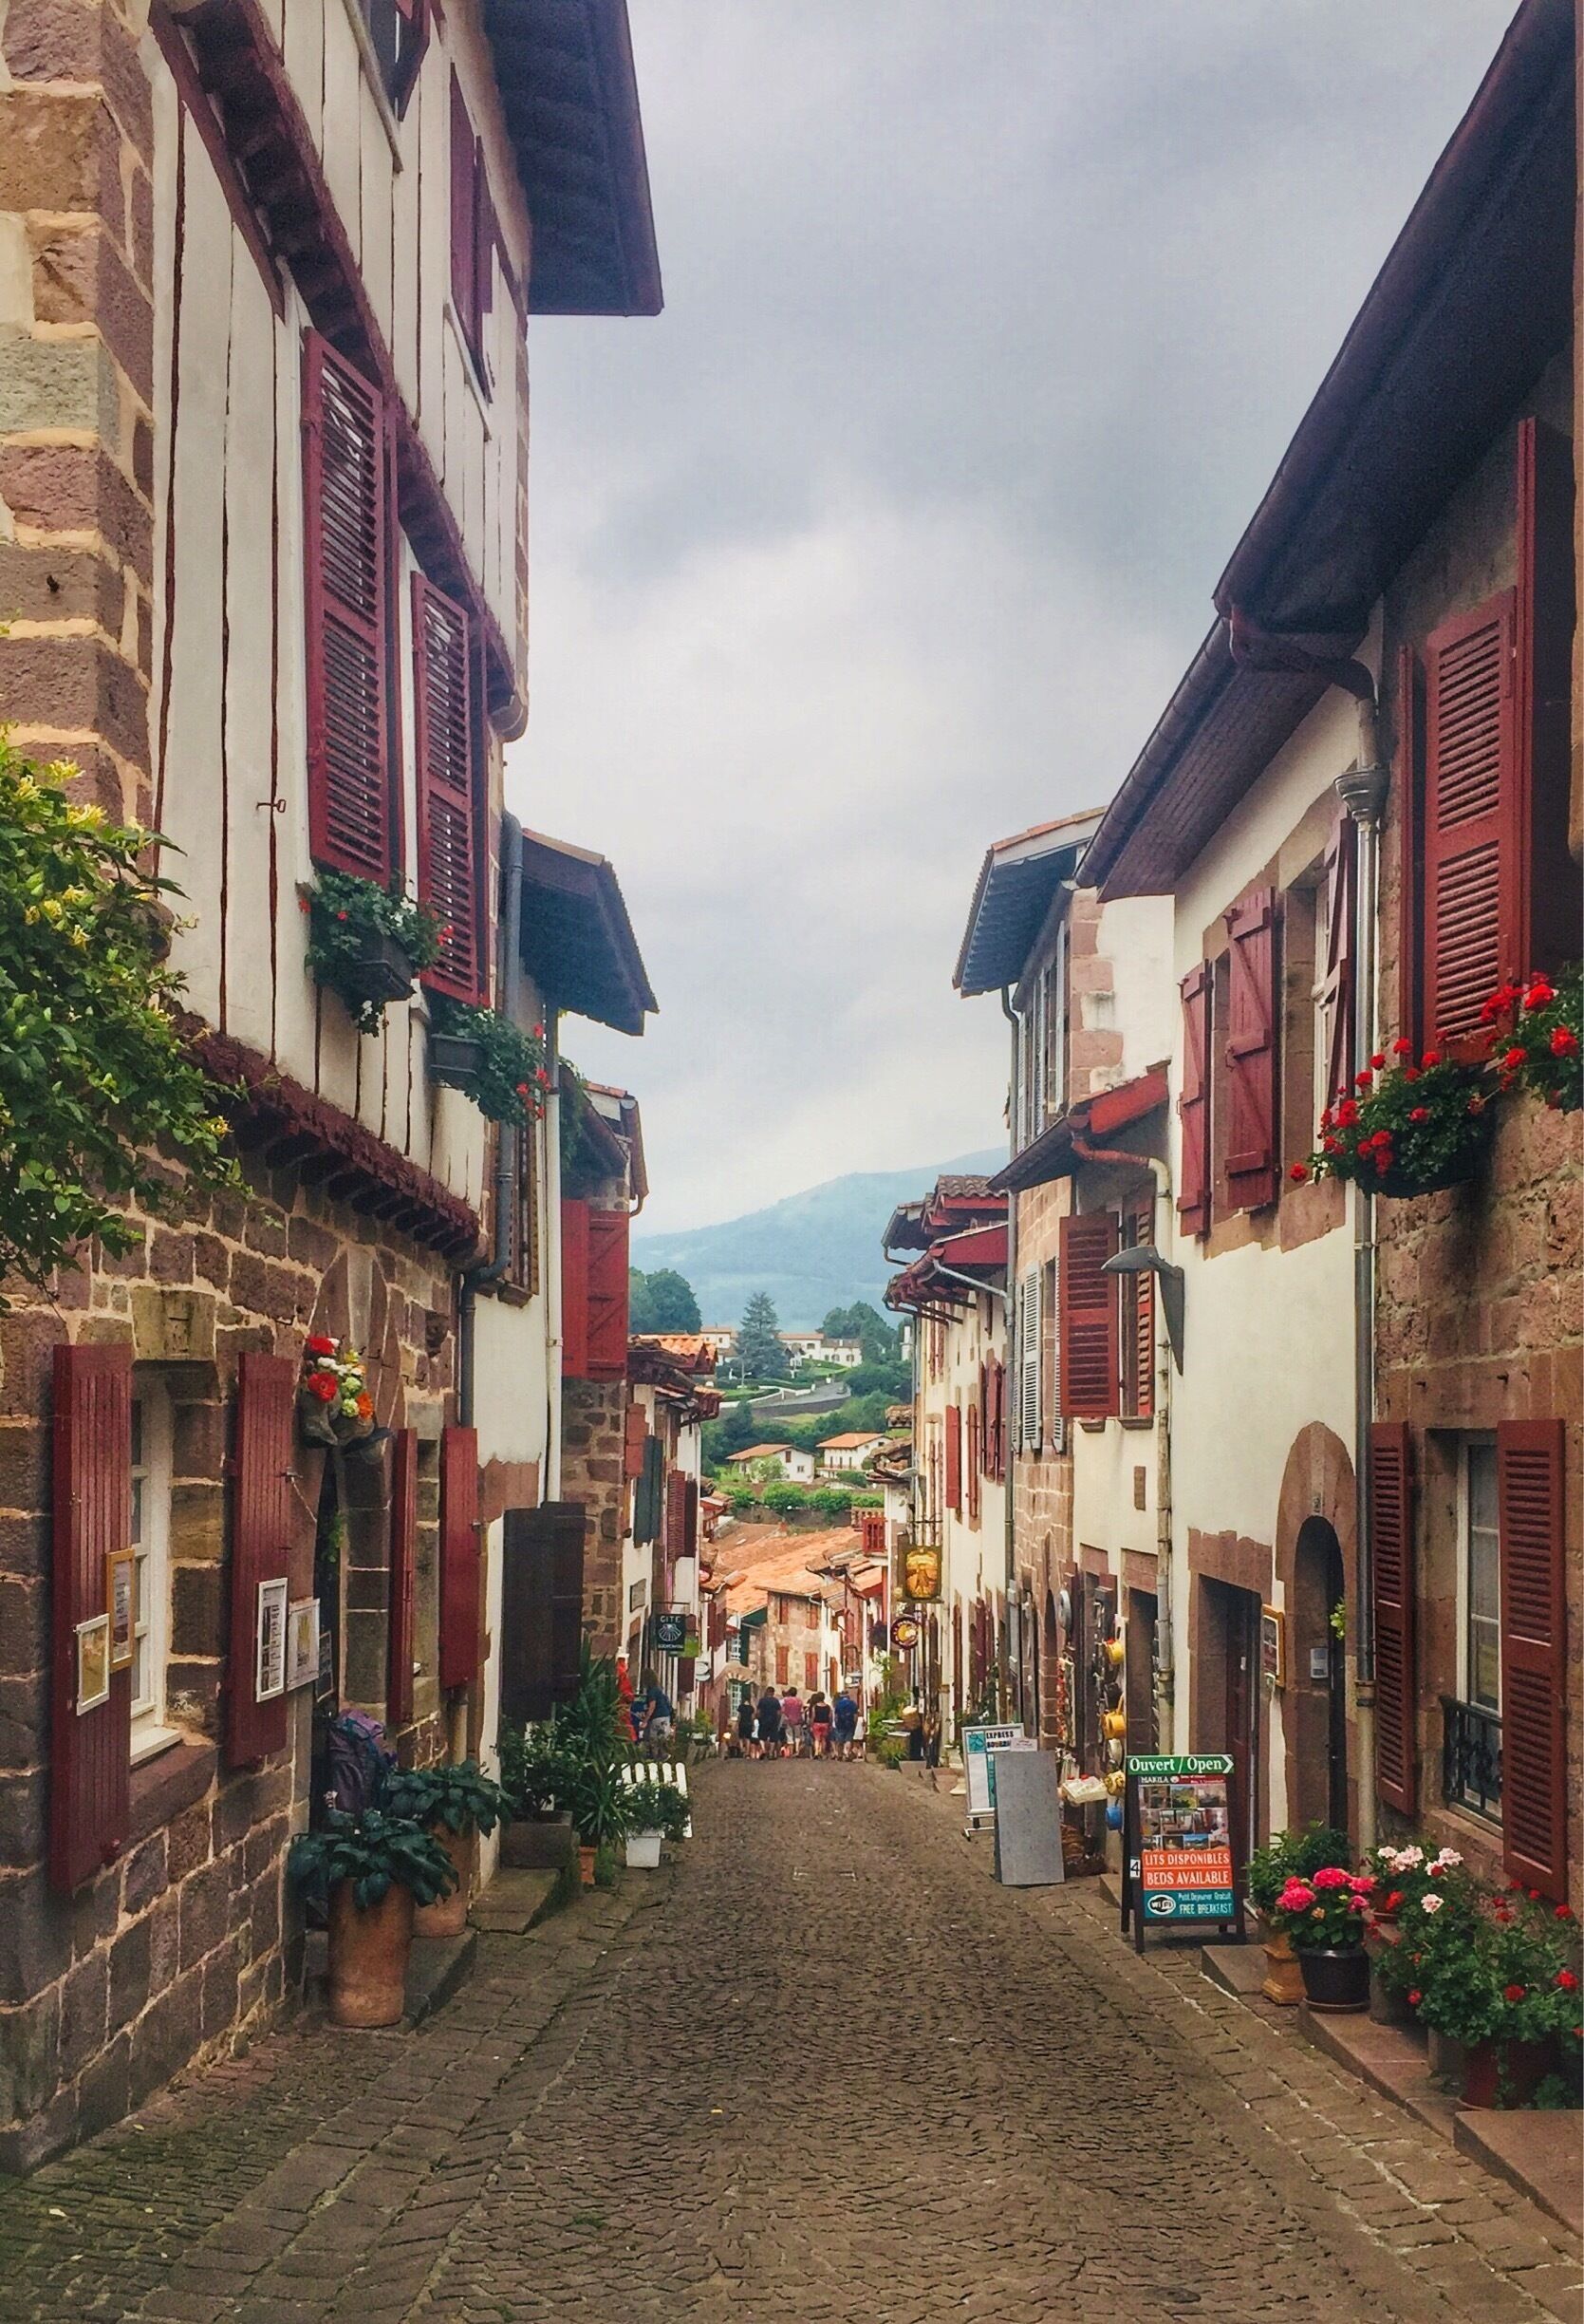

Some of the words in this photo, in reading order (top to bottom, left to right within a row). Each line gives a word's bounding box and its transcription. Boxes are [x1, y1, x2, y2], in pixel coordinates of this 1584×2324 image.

[986, 1731, 1015, 1739] EXPRESS
[1129, 1757, 1176, 1771] Ouvert
[1186, 1756, 1222, 1774] Open
[1145, 1853, 1165, 1866] LITS
[1167, 1852, 1230, 1865] DISPONIBLES
[1146, 1871, 1175, 1885] BEDS
[1177, 1870, 1230, 1884] AVAILABLE
[1179, 1903, 1196, 1915] FREE
[1197, 1902, 1233, 1915] BREAKFAST
